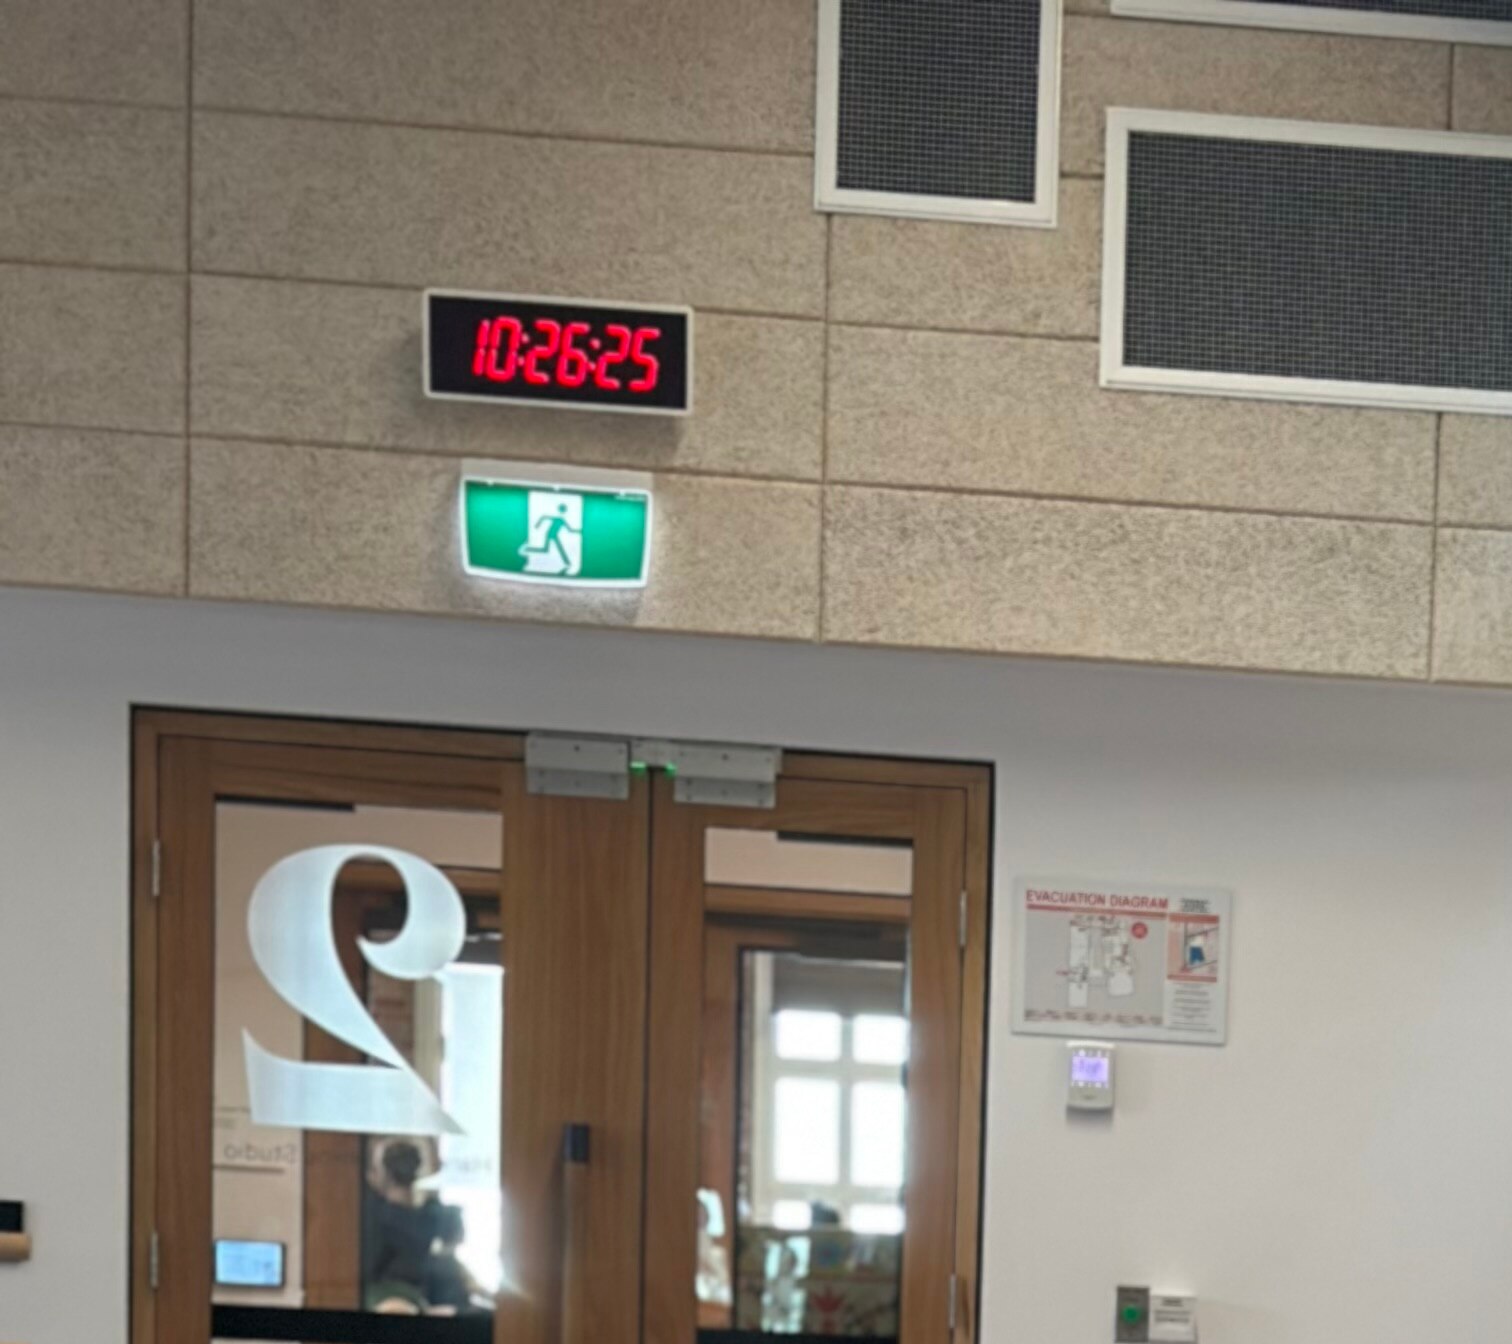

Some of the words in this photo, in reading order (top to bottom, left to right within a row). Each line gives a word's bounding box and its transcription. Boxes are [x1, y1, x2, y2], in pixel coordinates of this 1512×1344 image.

[472, 316, 662, 392] 10:26:25
[1026, 889, 1107, 906] EVACUATION
[1109, 895, 1169, 910] DIAGRAM
